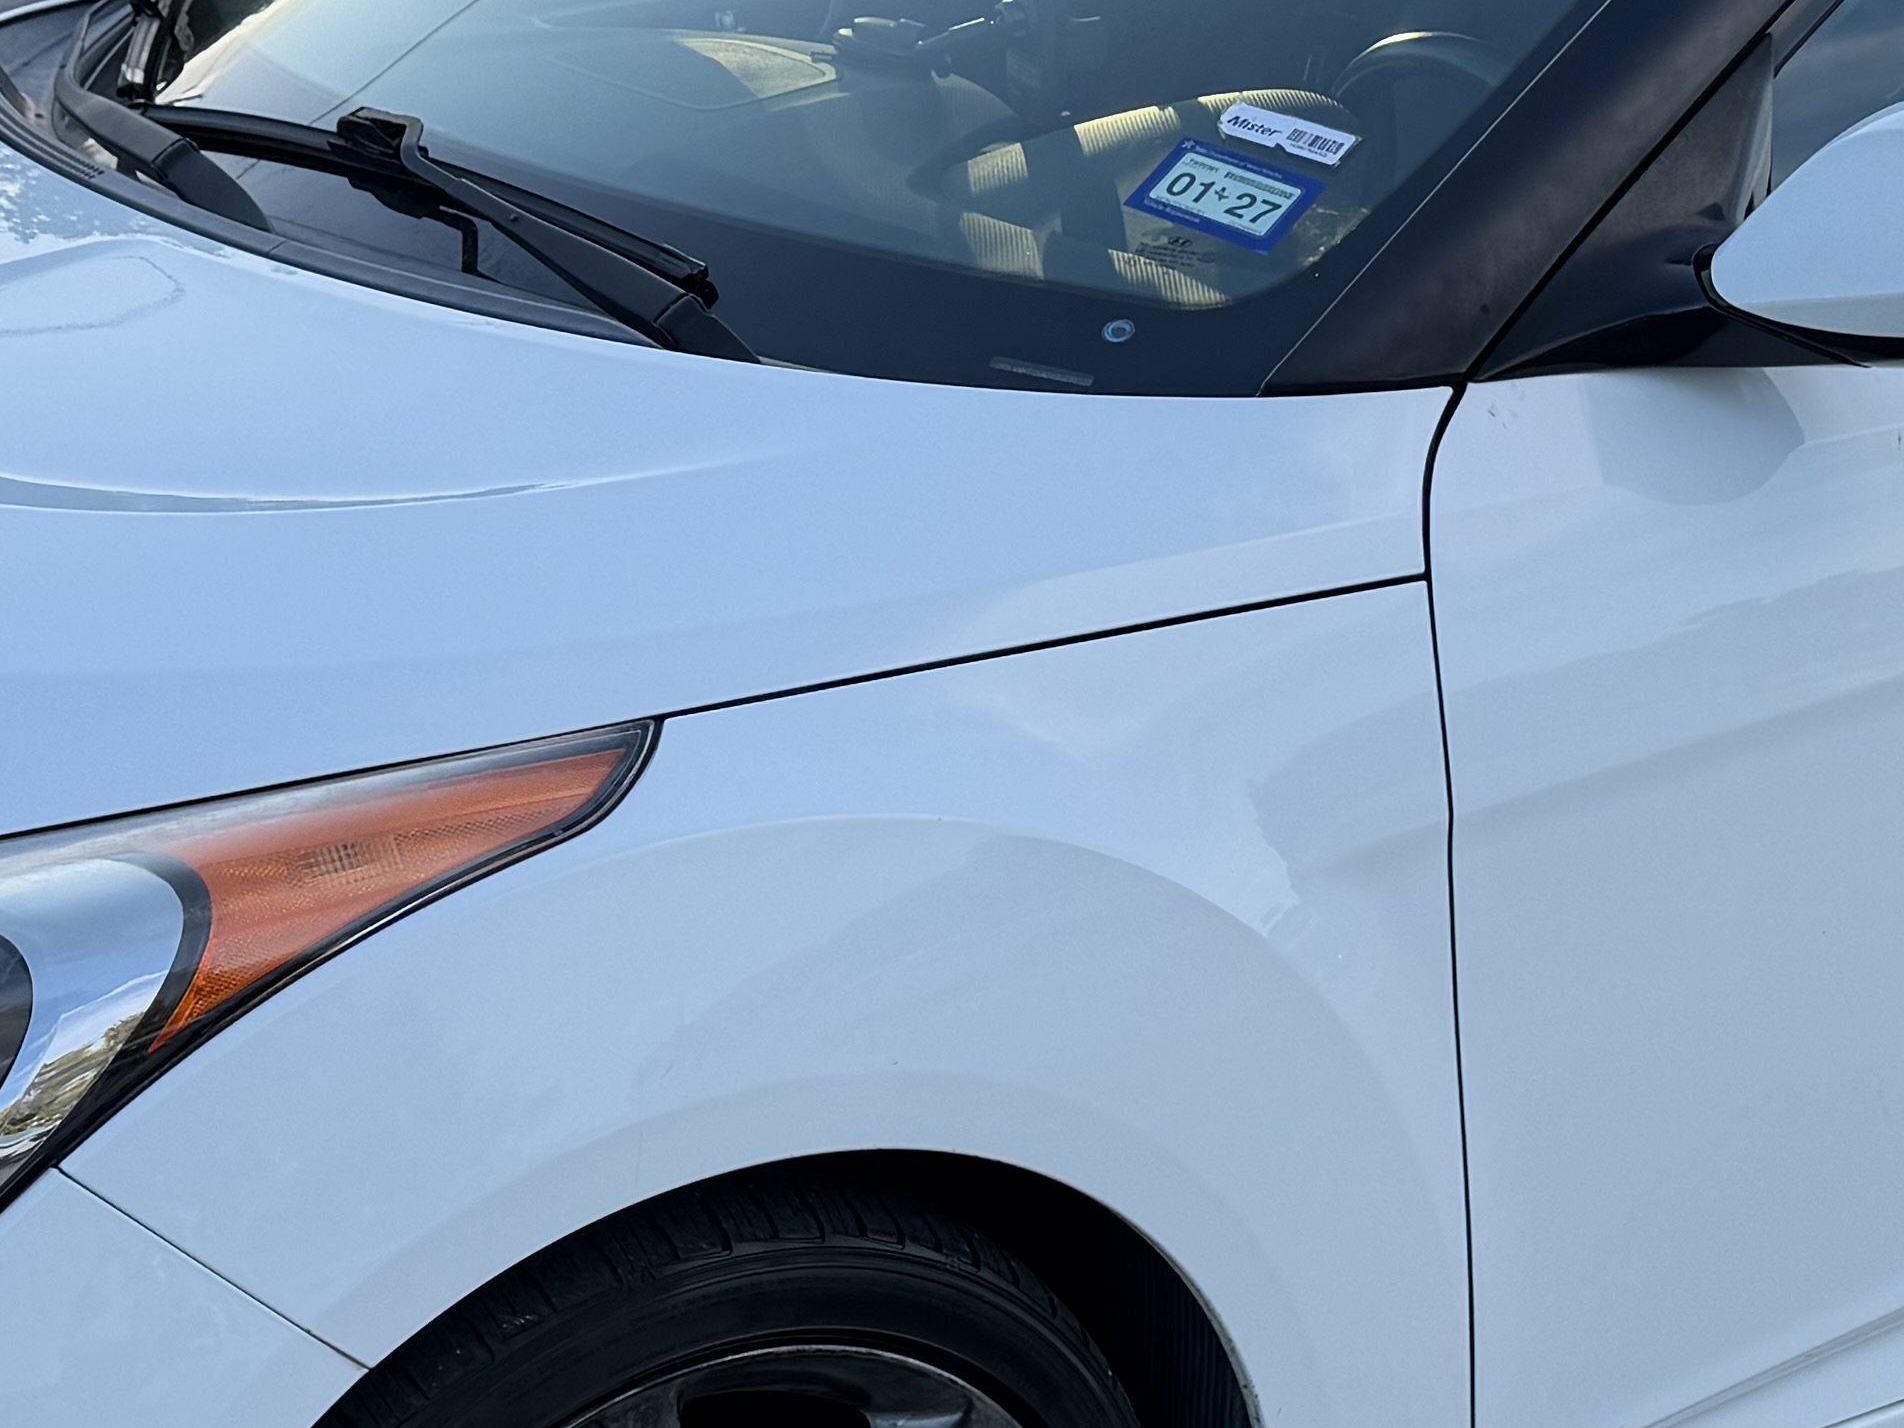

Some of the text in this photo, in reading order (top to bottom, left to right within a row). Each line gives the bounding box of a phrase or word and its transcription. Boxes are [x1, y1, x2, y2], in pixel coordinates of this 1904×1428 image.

[1227, 115, 1283, 137] Mister
[1166, 172, 1215, 203] 01
[1223, 192, 1282, 224] 27
